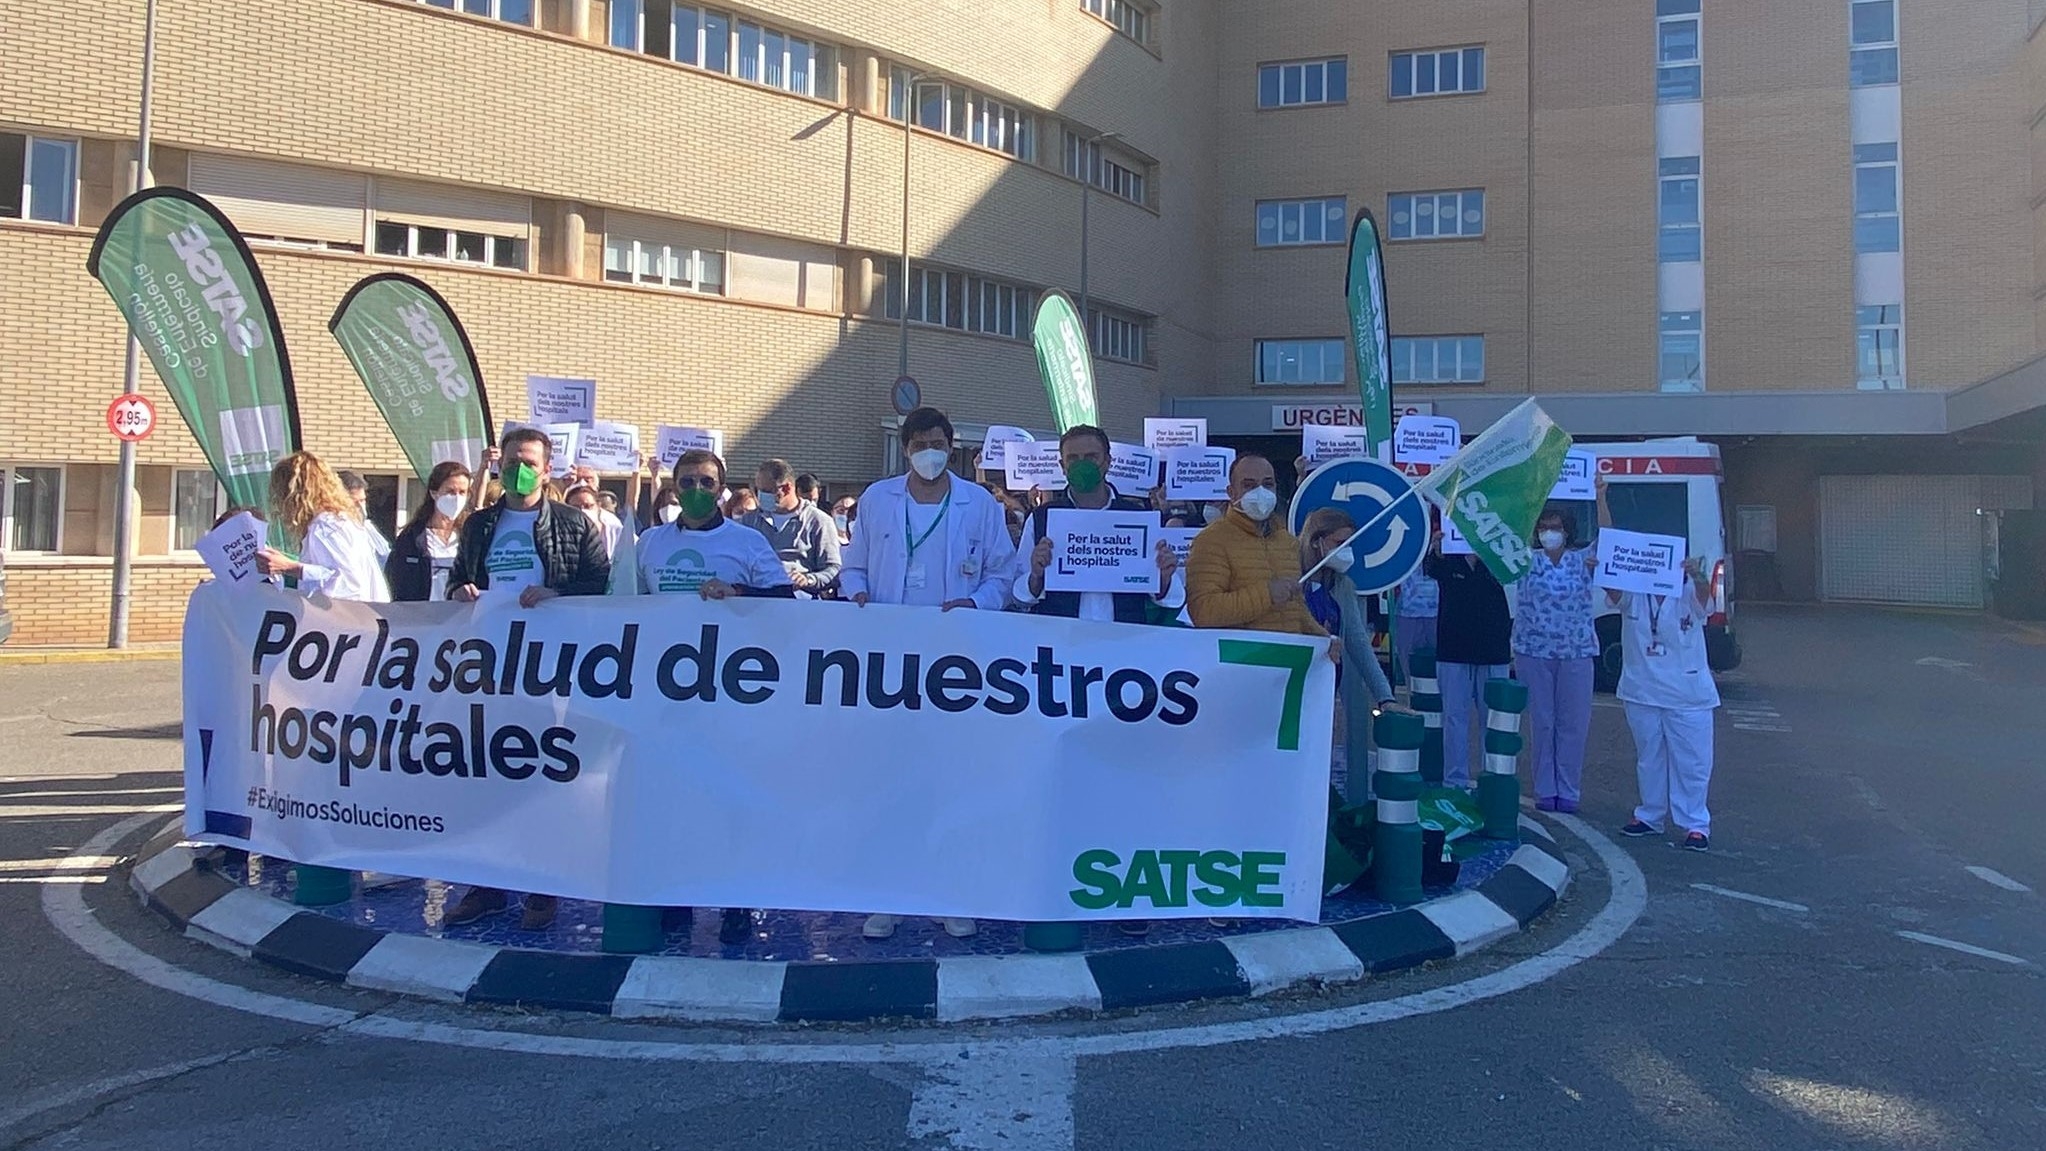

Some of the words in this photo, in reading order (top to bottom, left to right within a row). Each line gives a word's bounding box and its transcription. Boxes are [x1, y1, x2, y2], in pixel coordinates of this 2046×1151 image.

[1283, 405, 1418, 426] URGÈNES
[1108, 471, 1139, 480] ospitales
[1068, 533, 1088, 544] Per
[1090, 533, 1100, 544] la
[1103, 534, 1132, 545] salut
[1456, 491, 1529, 574] SATSE
[222, 538, 241, 553] Por
[241, 531, 254, 541] la
[229, 549, 243, 561] de
[1067, 545, 1092, 555] dels
[1094, 546, 1138, 556] nostres
[1614, 545, 1630, 553] Por
[1631, 548, 1639, 556] la
[1641, 550, 1665, 558] salud
[1066, 555, 1120, 568] hospitals
[1613, 553, 1625, 561] de
[1627, 556, 1665, 567] nuestros
[1612, 561, 1657, 574] hospitales
[252, 610, 361, 684] Por
[361, 618, 420, 693] la
[428, 621, 639, 699] salud
[656, 623, 781, 704] de
[805, 646, 1200, 726] nuestros
[250, 684, 581, 787] hospitales
[247, 785, 445, 833] #ExigimosSoluciones
[1069, 849, 1286, 910] SATSE
